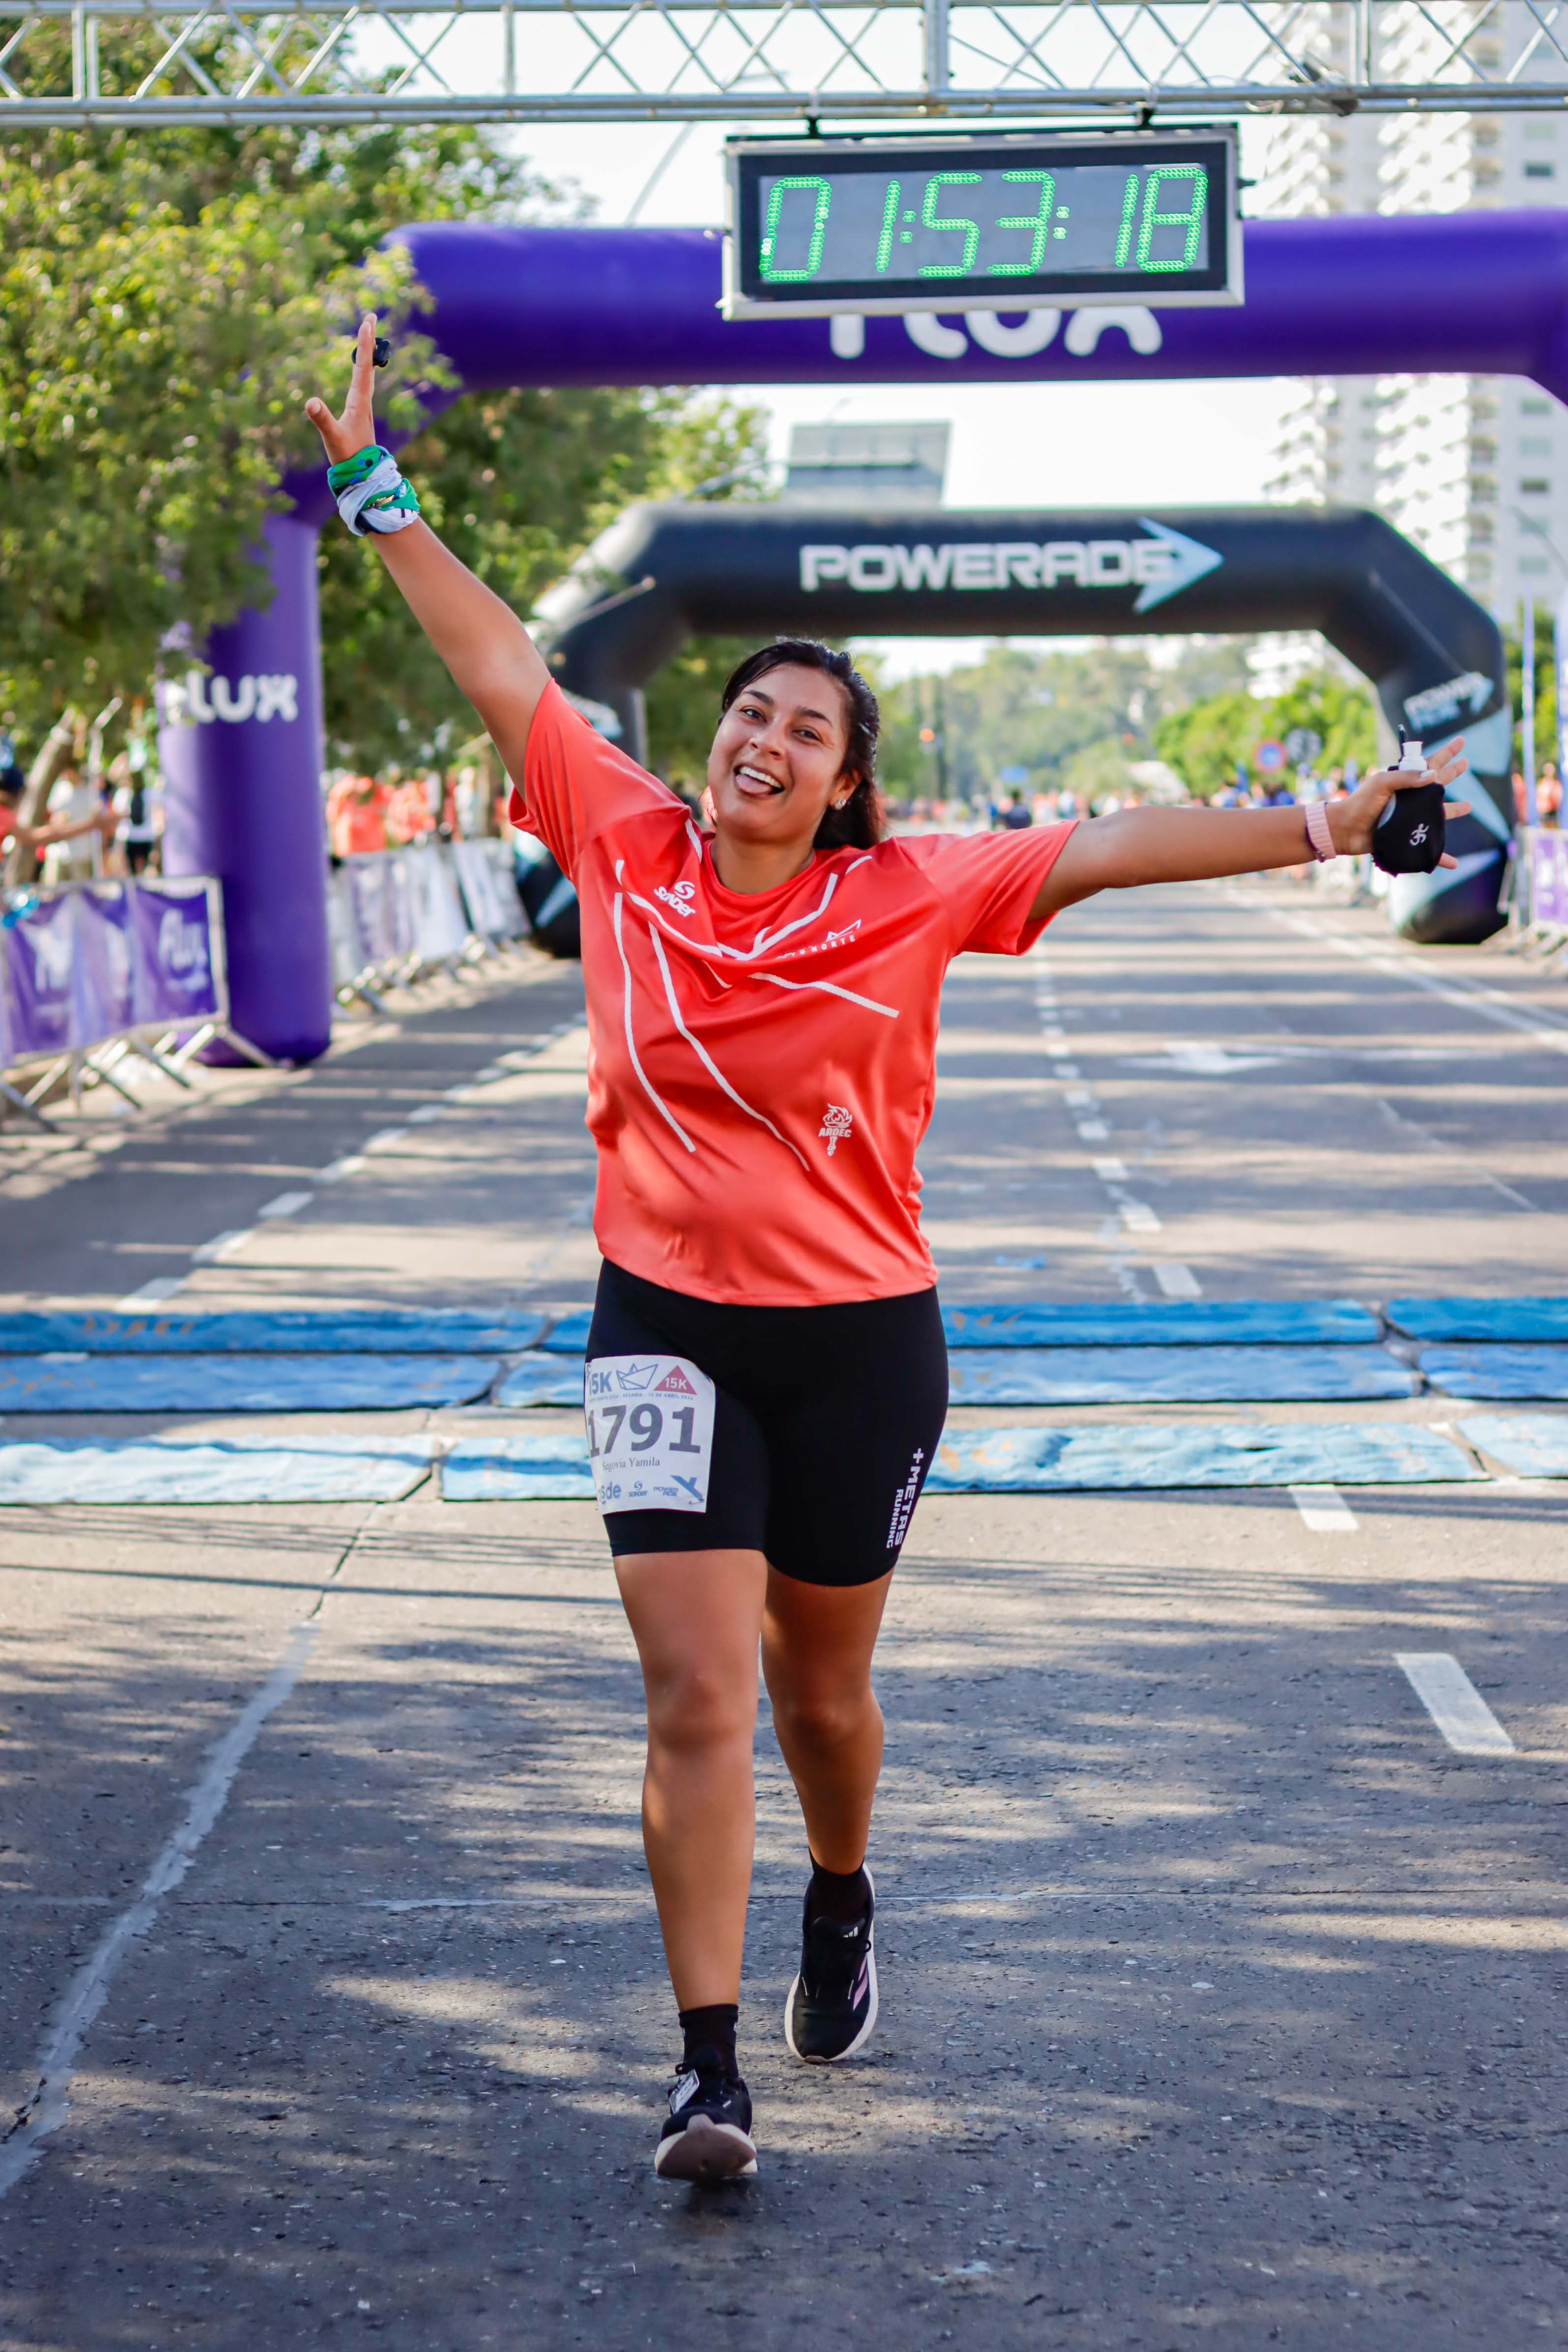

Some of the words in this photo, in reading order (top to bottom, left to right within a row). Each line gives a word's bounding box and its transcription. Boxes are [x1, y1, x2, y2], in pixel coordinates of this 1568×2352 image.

[799, 539, 1174, 591] POWERADE
[811, 935, 856, 952] NORTE
[818, 1127, 852, 1138] ARDEC
[665, 1377, 687, 1390] 15K
[588, 1403, 701, 1458] 1791
[602, 1461, 626, 1472] Segovia
[629, 1457, 660, 1467] Yamila
